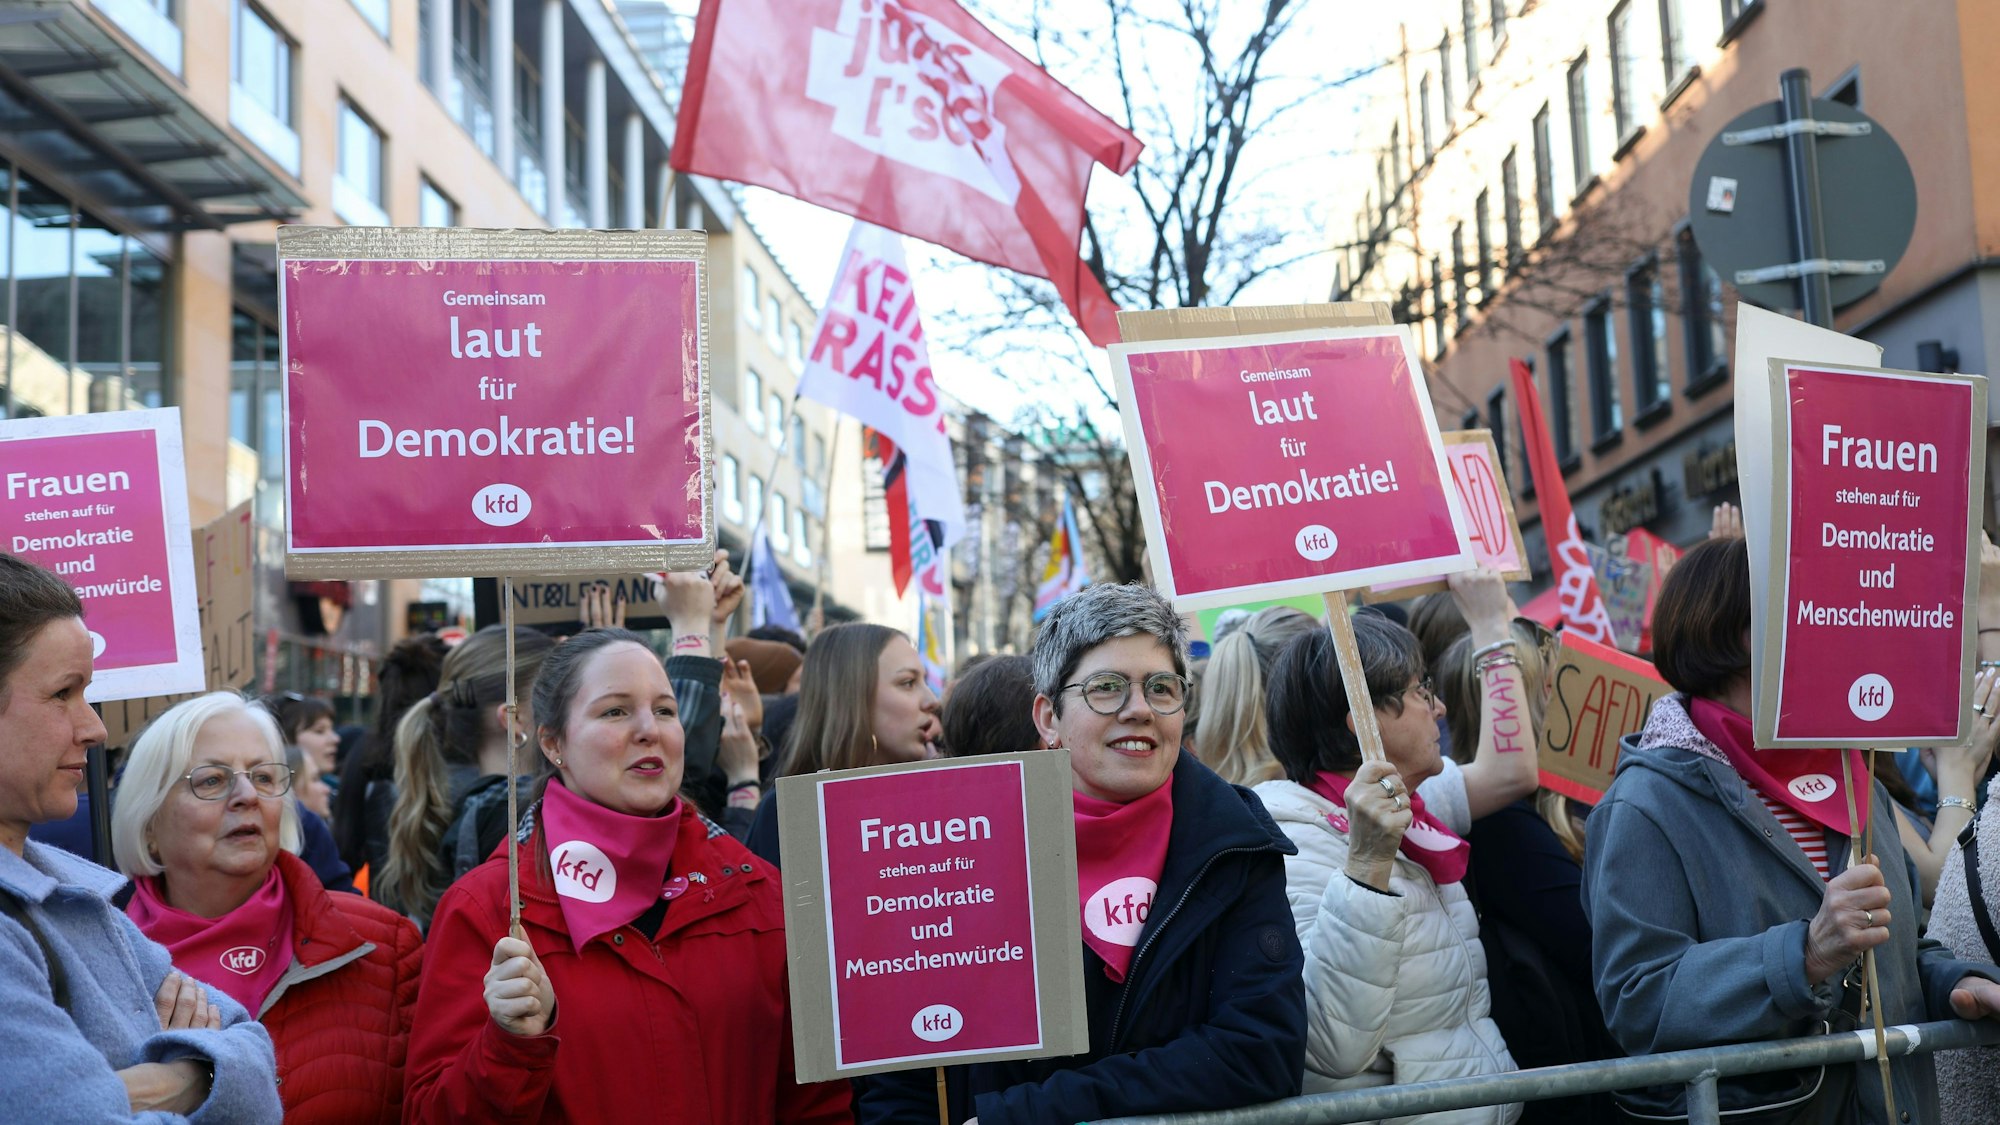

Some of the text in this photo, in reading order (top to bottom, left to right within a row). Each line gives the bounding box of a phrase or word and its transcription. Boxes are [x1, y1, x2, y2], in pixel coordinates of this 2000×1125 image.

[443, 291, 545, 305] Gemeinsam
[451, 316, 541, 358] laut
[1241, 368, 1311, 382] Gemeinsam
[479, 376, 516, 400] für
[1249, 391, 1317, 425] laut
[359, 416, 634, 457] Demokratie!
[1280, 438, 1306, 457] für
[1823, 424, 1937, 472] Frauen
[7, 471, 129, 499] Frauen
[1204, 460, 1398, 513] Demokratie!
[1836, 487, 1920, 507] stehen auf für
[25, 504, 114, 521] stehen auf für
[486, 495, 517, 513] kfd
[13, 527, 133, 553] Demokratie
[1304, 533, 1328, 550] kfd
[1823, 523, 1934, 551] Demokratie
[56, 554, 95, 574] und
[1860, 563, 1894, 588] und
[74, 575, 161, 599] enwürde
[1797, 601, 1953, 628] Menschenwürde
[1859, 686, 1883, 706] kfd
[1796, 778, 1827, 796] kfd
[861, 816, 990, 852] Frauen
[556, 850, 603, 892] kfd
[880, 857, 975, 878] stehen auf für
[867, 884, 994, 916] Demokratie
[1103, 892, 1152, 927] kfd
[912, 916, 952, 940] und
[228, 950, 257, 969] kfd
[846, 941, 1023, 978] Menschenwürde
[923, 1014, 951, 1031] kfd
